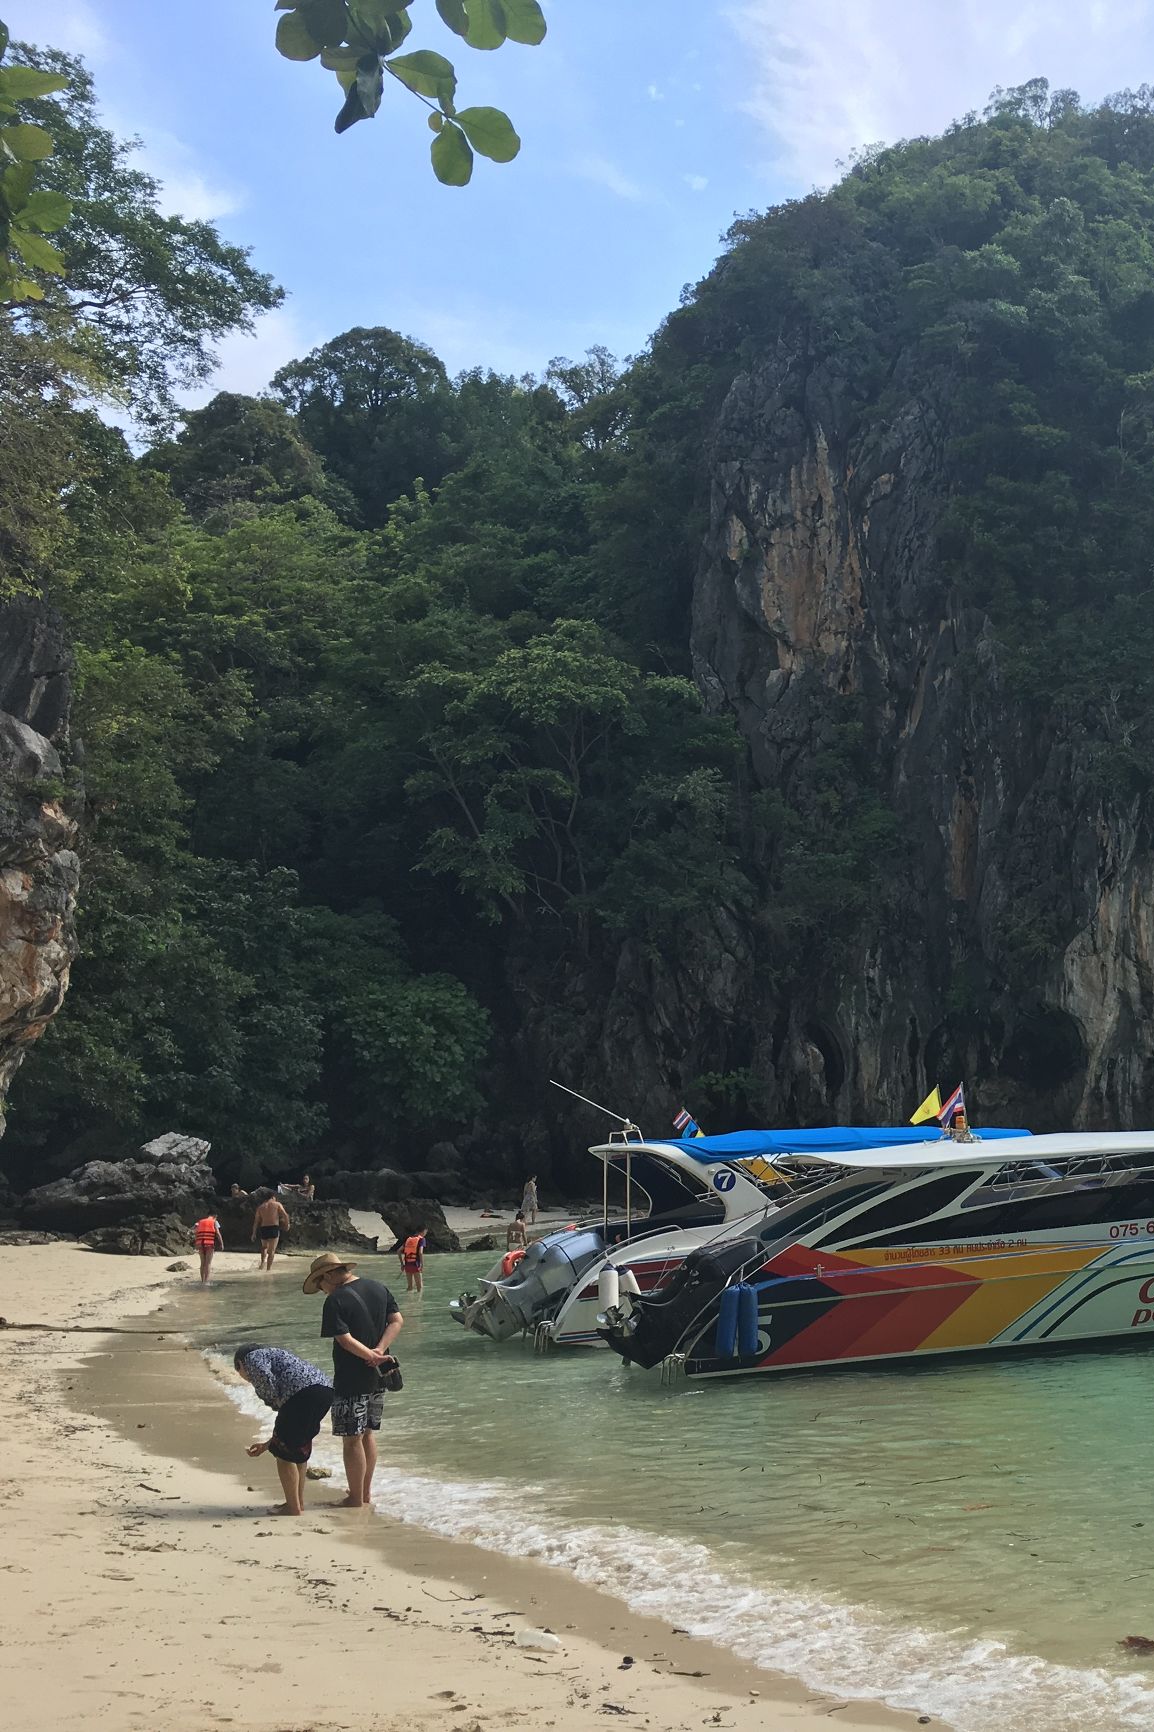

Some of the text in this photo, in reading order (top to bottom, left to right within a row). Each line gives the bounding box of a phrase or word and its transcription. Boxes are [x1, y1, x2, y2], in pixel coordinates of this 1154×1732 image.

[717, 1172, 732, 1189] 7
[939, 1246, 950, 1256] 33
[1008, 1239, 1015, 1248] 2
